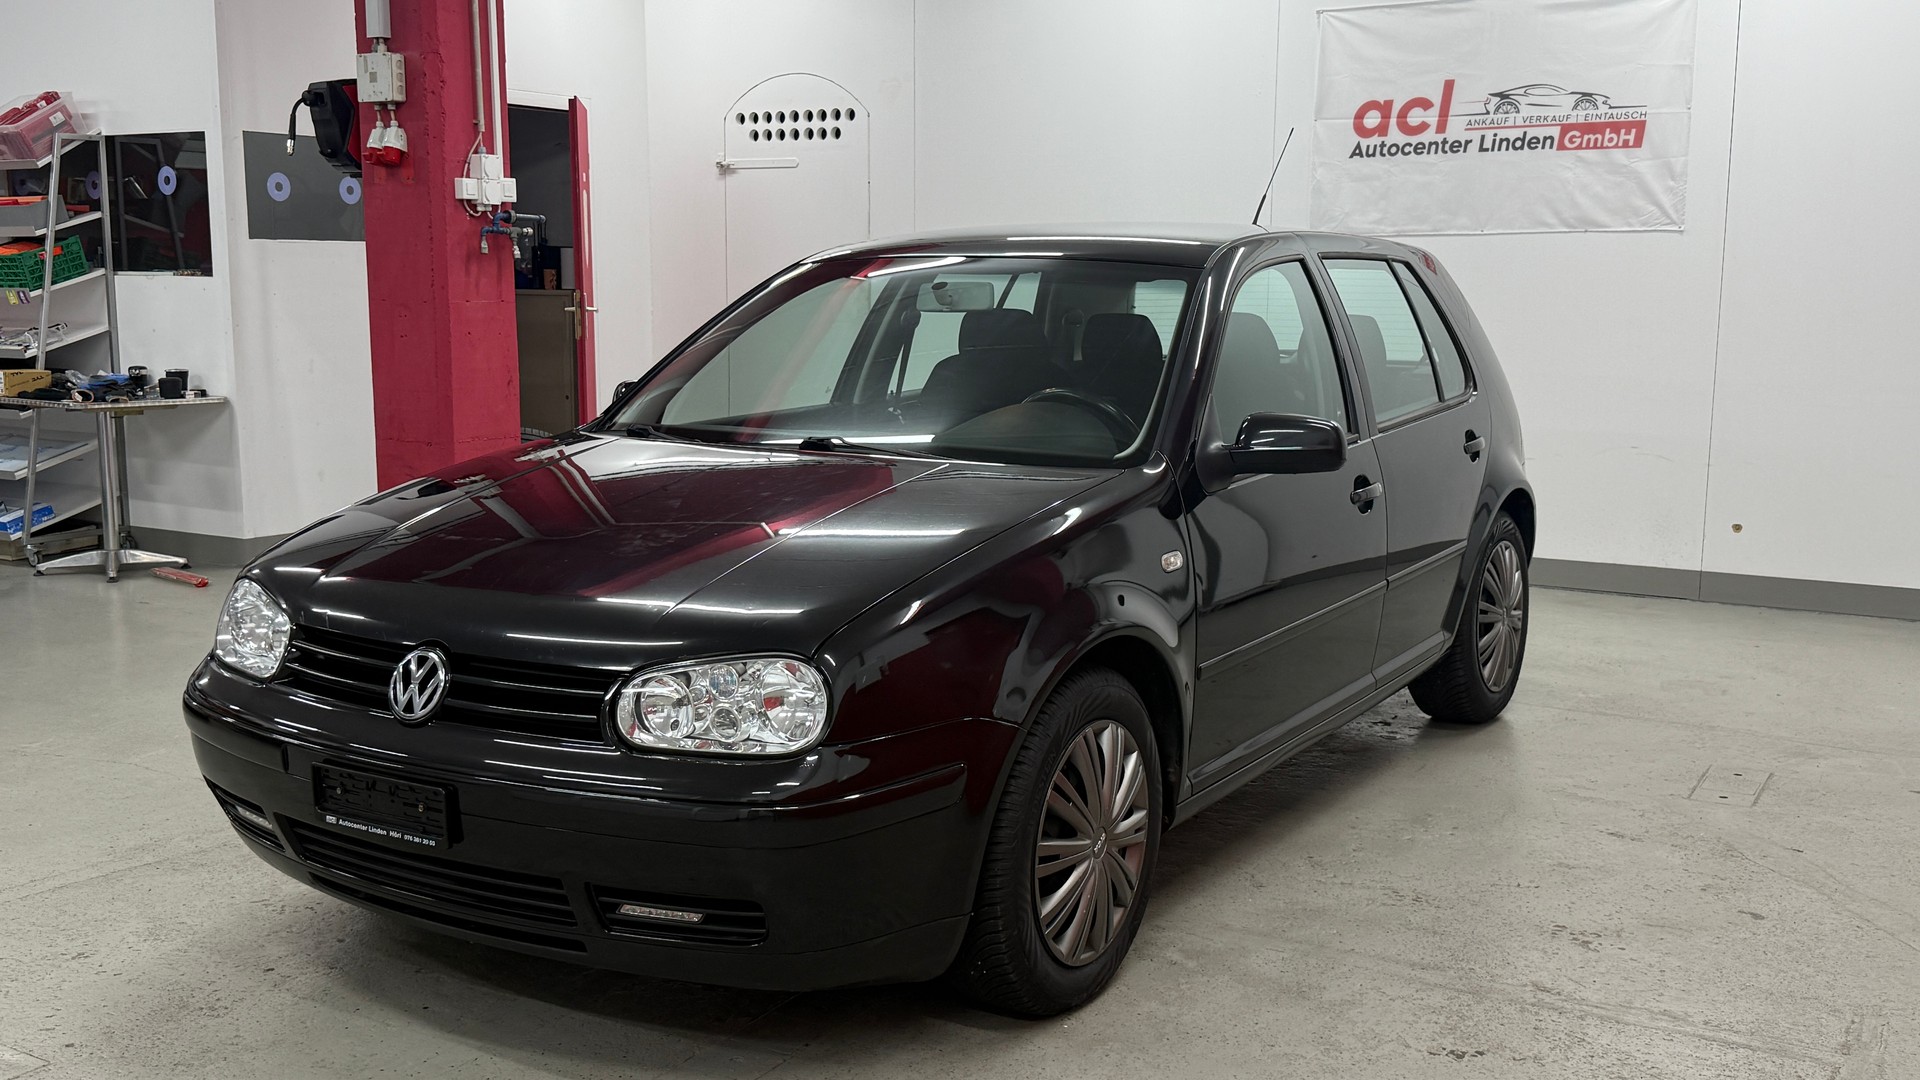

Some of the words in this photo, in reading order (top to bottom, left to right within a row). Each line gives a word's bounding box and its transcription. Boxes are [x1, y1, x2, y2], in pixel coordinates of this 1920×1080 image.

[1353, 79, 1455, 139] acl
[1466, 116, 1510, 127] ANKAUF
[1522, 113, 1572, 124] VERKAUF
[1584, 110, 1648, 122] EINTAUSCH
[1349, 137, 1473, 159] Autocenter
[1478, 131, 1555, 153] Linden
[1563, 128, 1637, 149] GmbH
[339, 818, 368, 831] Autocenter
[368, 825, 387, 836] Linden
